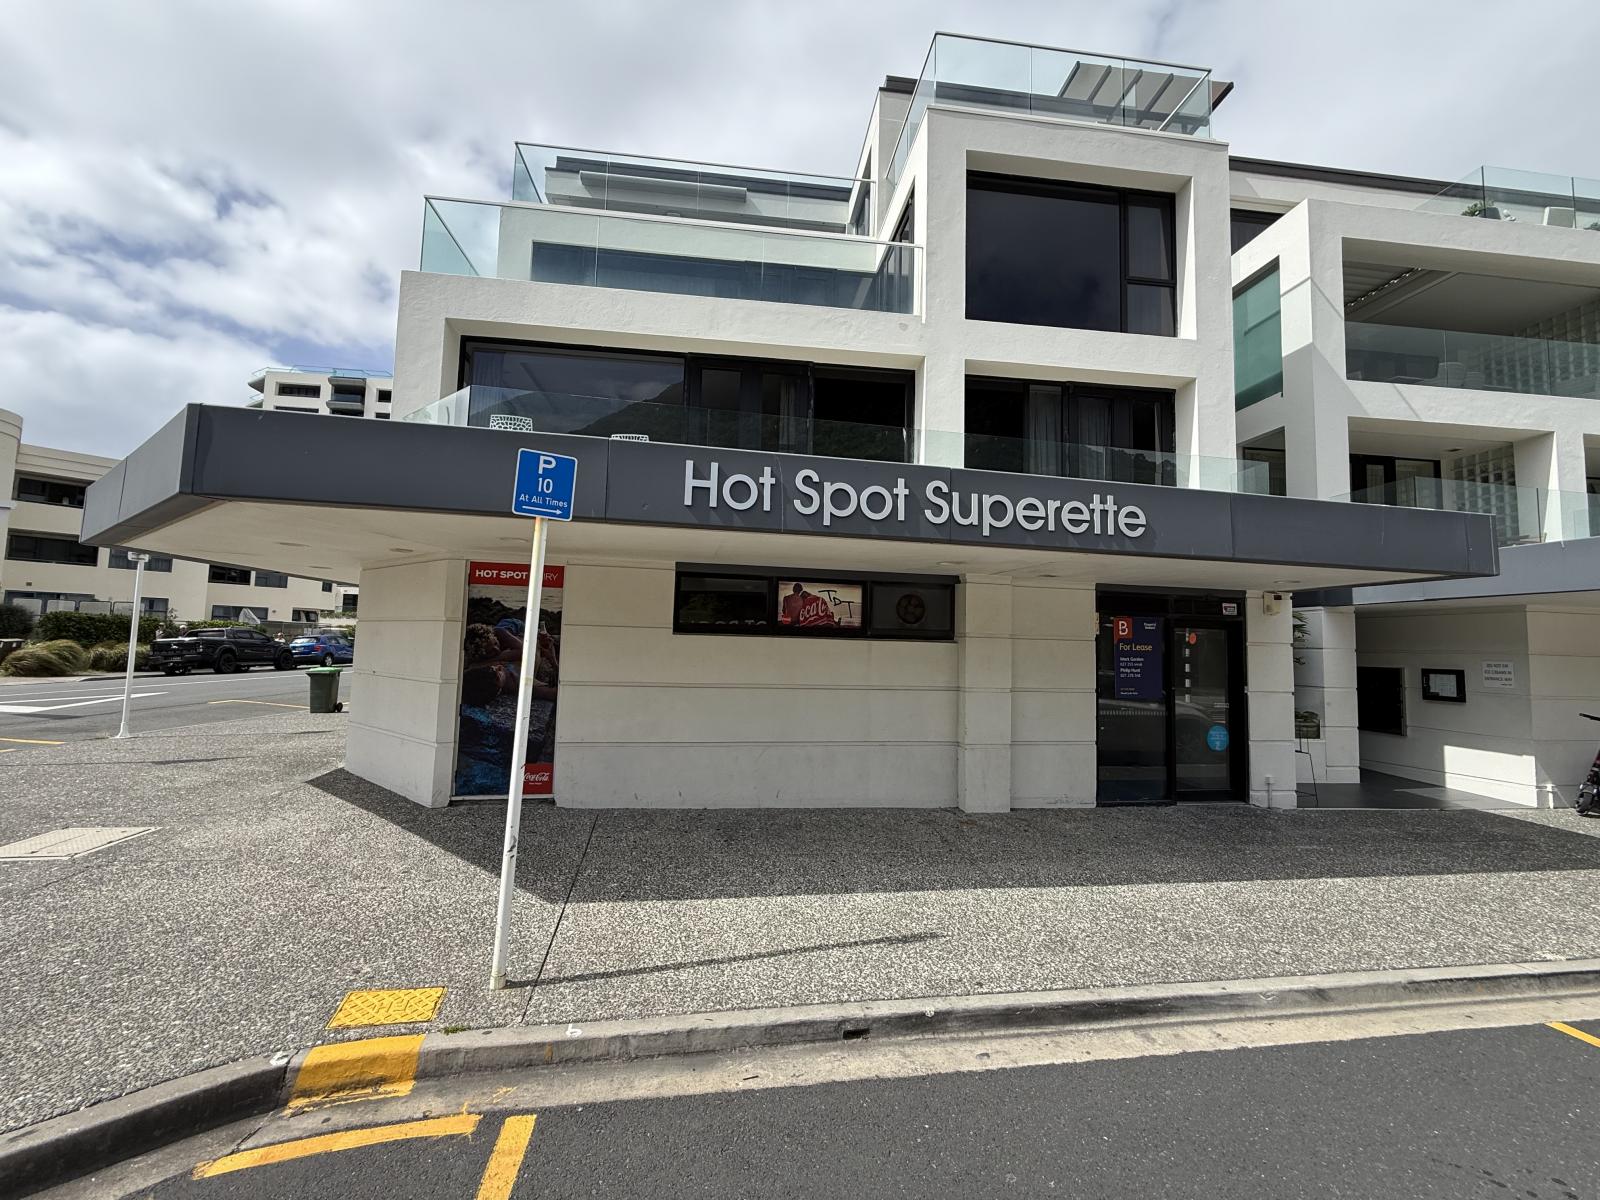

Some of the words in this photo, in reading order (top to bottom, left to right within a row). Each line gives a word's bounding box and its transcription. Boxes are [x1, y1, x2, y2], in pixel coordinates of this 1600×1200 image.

[538, 455, 557, 474] P
[538, 477, 553, 493] 10
[519, 493, 529, 502] At
[531, 495, 543, 504] All
[545, 497, 568, 508] Times
[684, 460, 776, 512] Hot
[794, 469, 910, 526] Spot
[924, 480, 1147, 538] Superette
[475, 569, 499, 579] HOT
[499, 570, 528, 580] SPOT
[1118, 620, 1129, 635] B
[1119, 643, 1132, 651] For
[1132, 643, 1153, 651] Lease
